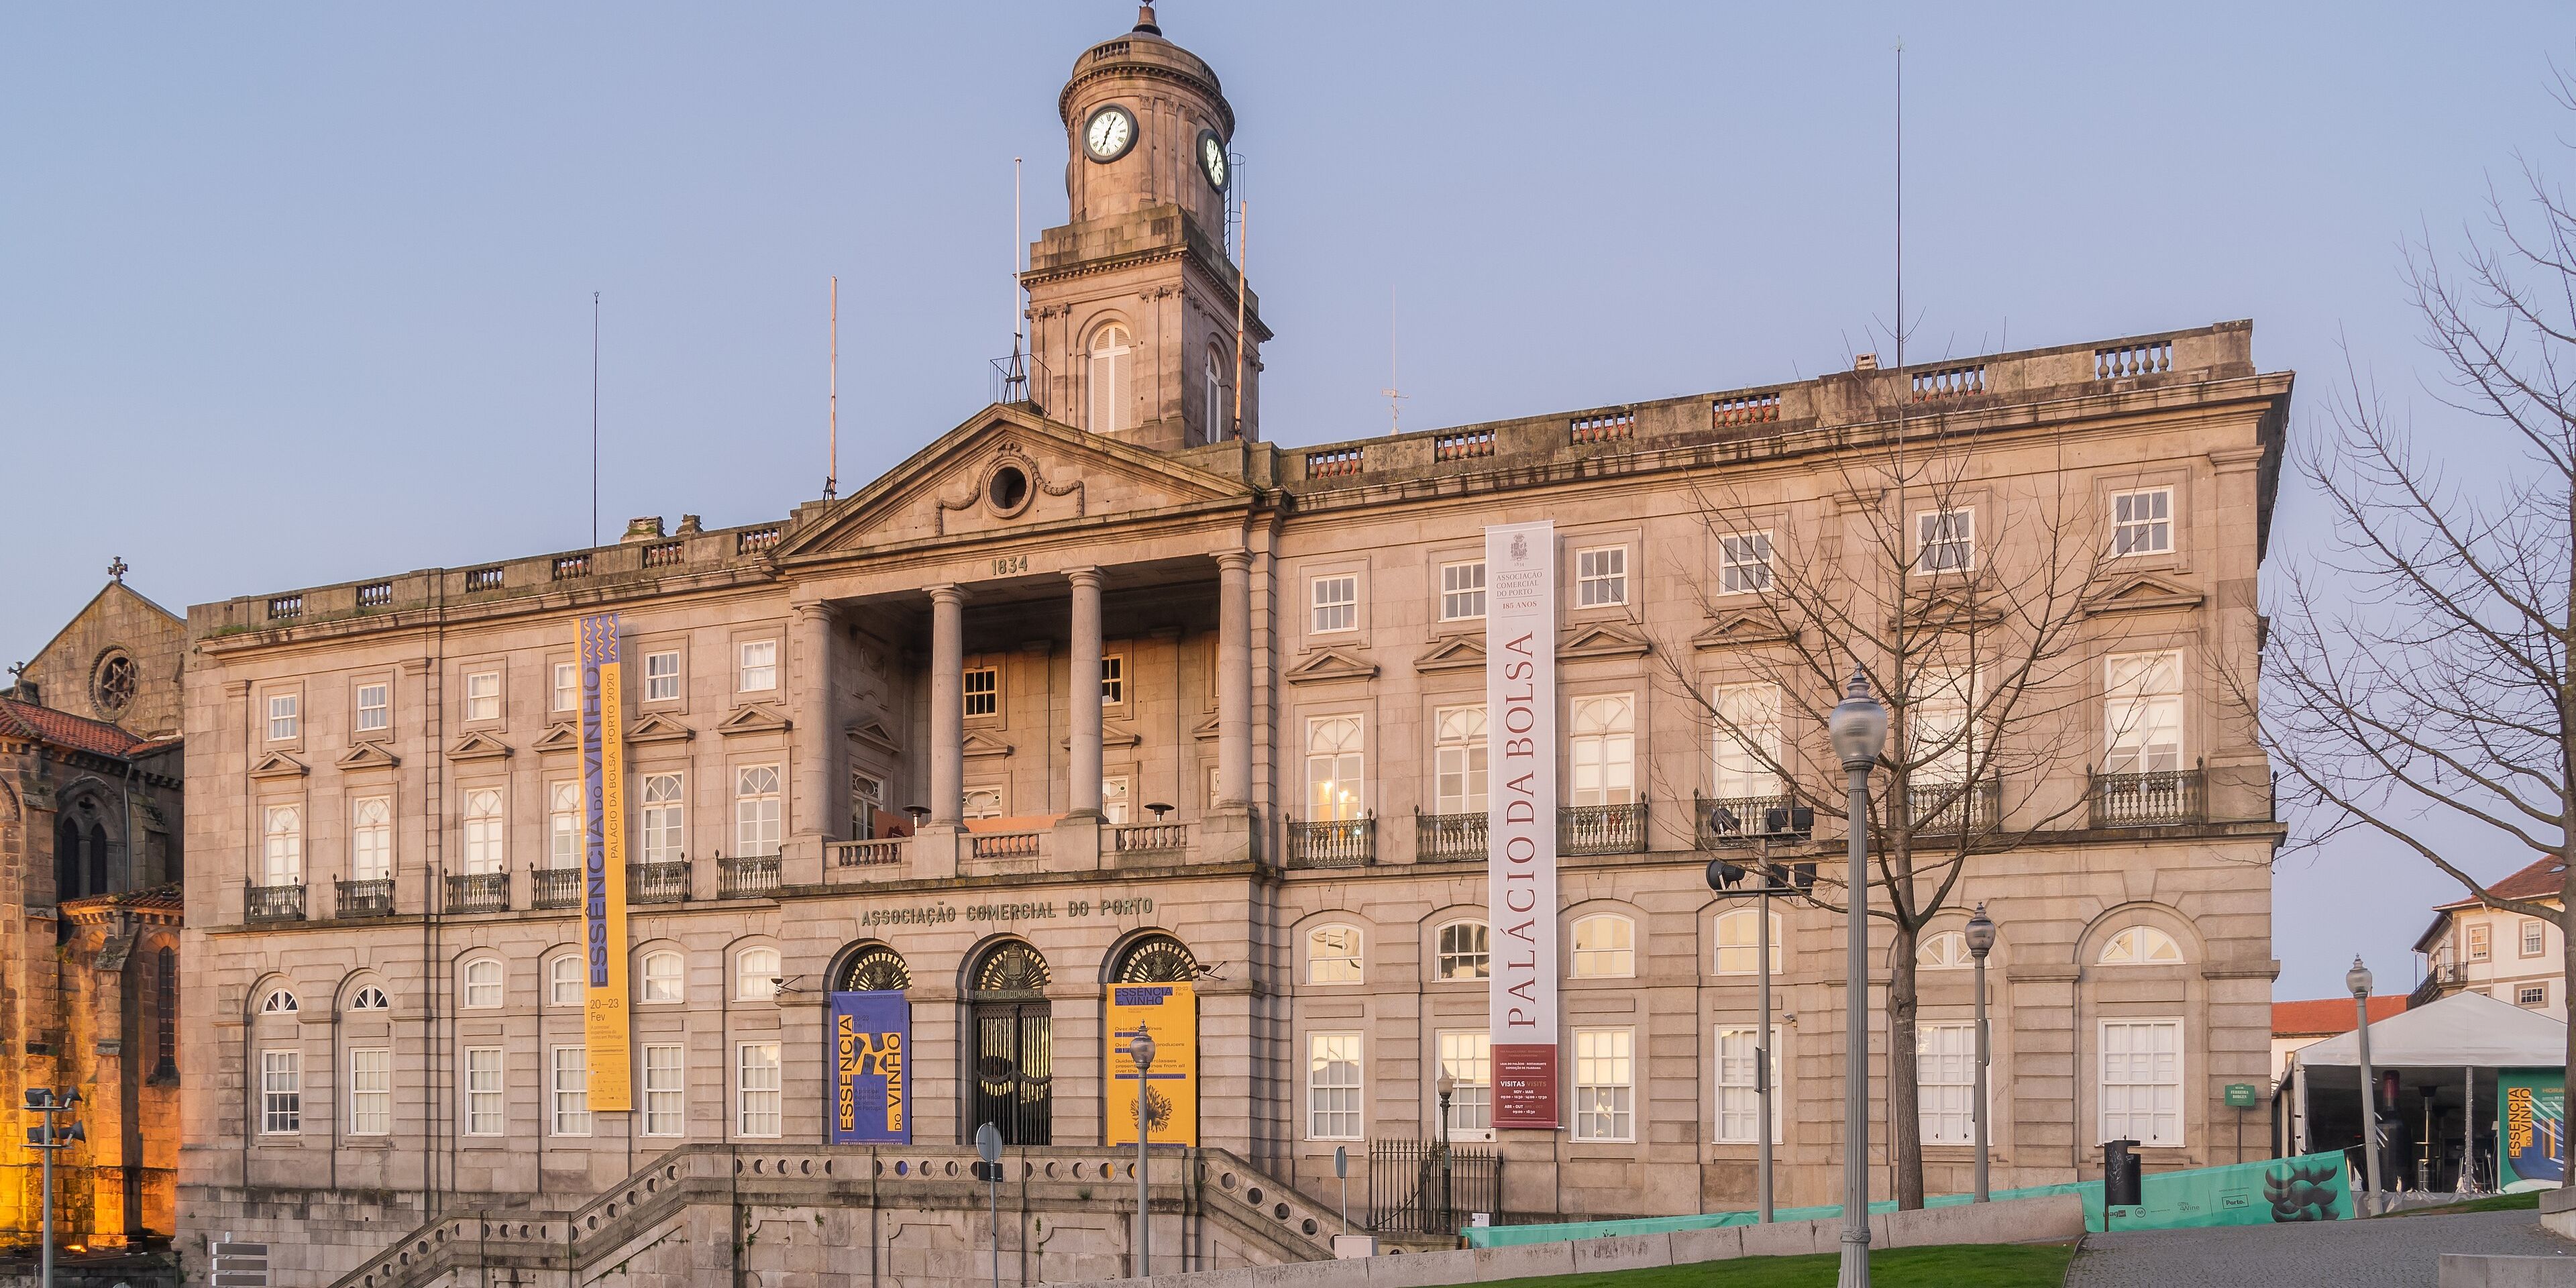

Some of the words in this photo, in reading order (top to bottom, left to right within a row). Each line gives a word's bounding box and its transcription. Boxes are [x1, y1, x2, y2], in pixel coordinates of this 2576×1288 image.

[991, 555, 1028, 576] 1834
[1497, 572, 1542, 581] ASSOCIAÇÃO
[1496, 580, 1539, 589] COMERCIAL
[1509, 588, 1533, 596] PORTO
[1505, 630, 1534, 759] BOLSA
[584, 666, 602, 780] VINHO
[594, 786, 604, 811] DO
[610, 791, 616, 807] DA
[1506, 770, 1534, 826] DA
[610, 809, 619, 859] PALÁCIO
[585, 814, 608, 987] ESSÊNCIA
[861, 902, 956, 926] ASSOCIAÇÃO
[966, 902, 1057, 921] COMERCIAL
[1068, 900, 1089, 917] DO
[1100, 898, 1153, 916] PORTO
[1500, 836, 1536, 1028] PALÁCIO
[974, 990, 996, 1001] PRAÇA
[998, 991, 1007, 999] DO
[1009, 989, 1044, 998] COMMERC
[1115, 985, 1173, 997] ESSÊNCIA
[1126, 996, 1163, 1005] VINHO
[591, 1012, 606, 1022] Fev
[838, 1016, 853, 1131] ESSÊNCIA
[888, 1034, 901, 1108] VINHO
[894, 1114, 902, 1130] DO
[2507, 1088, 2520, 1158] ESSÊNCIA
[2520, 1088, 2532, 1133] VINHO
[2526, 1136, 2532, 1146] DO
